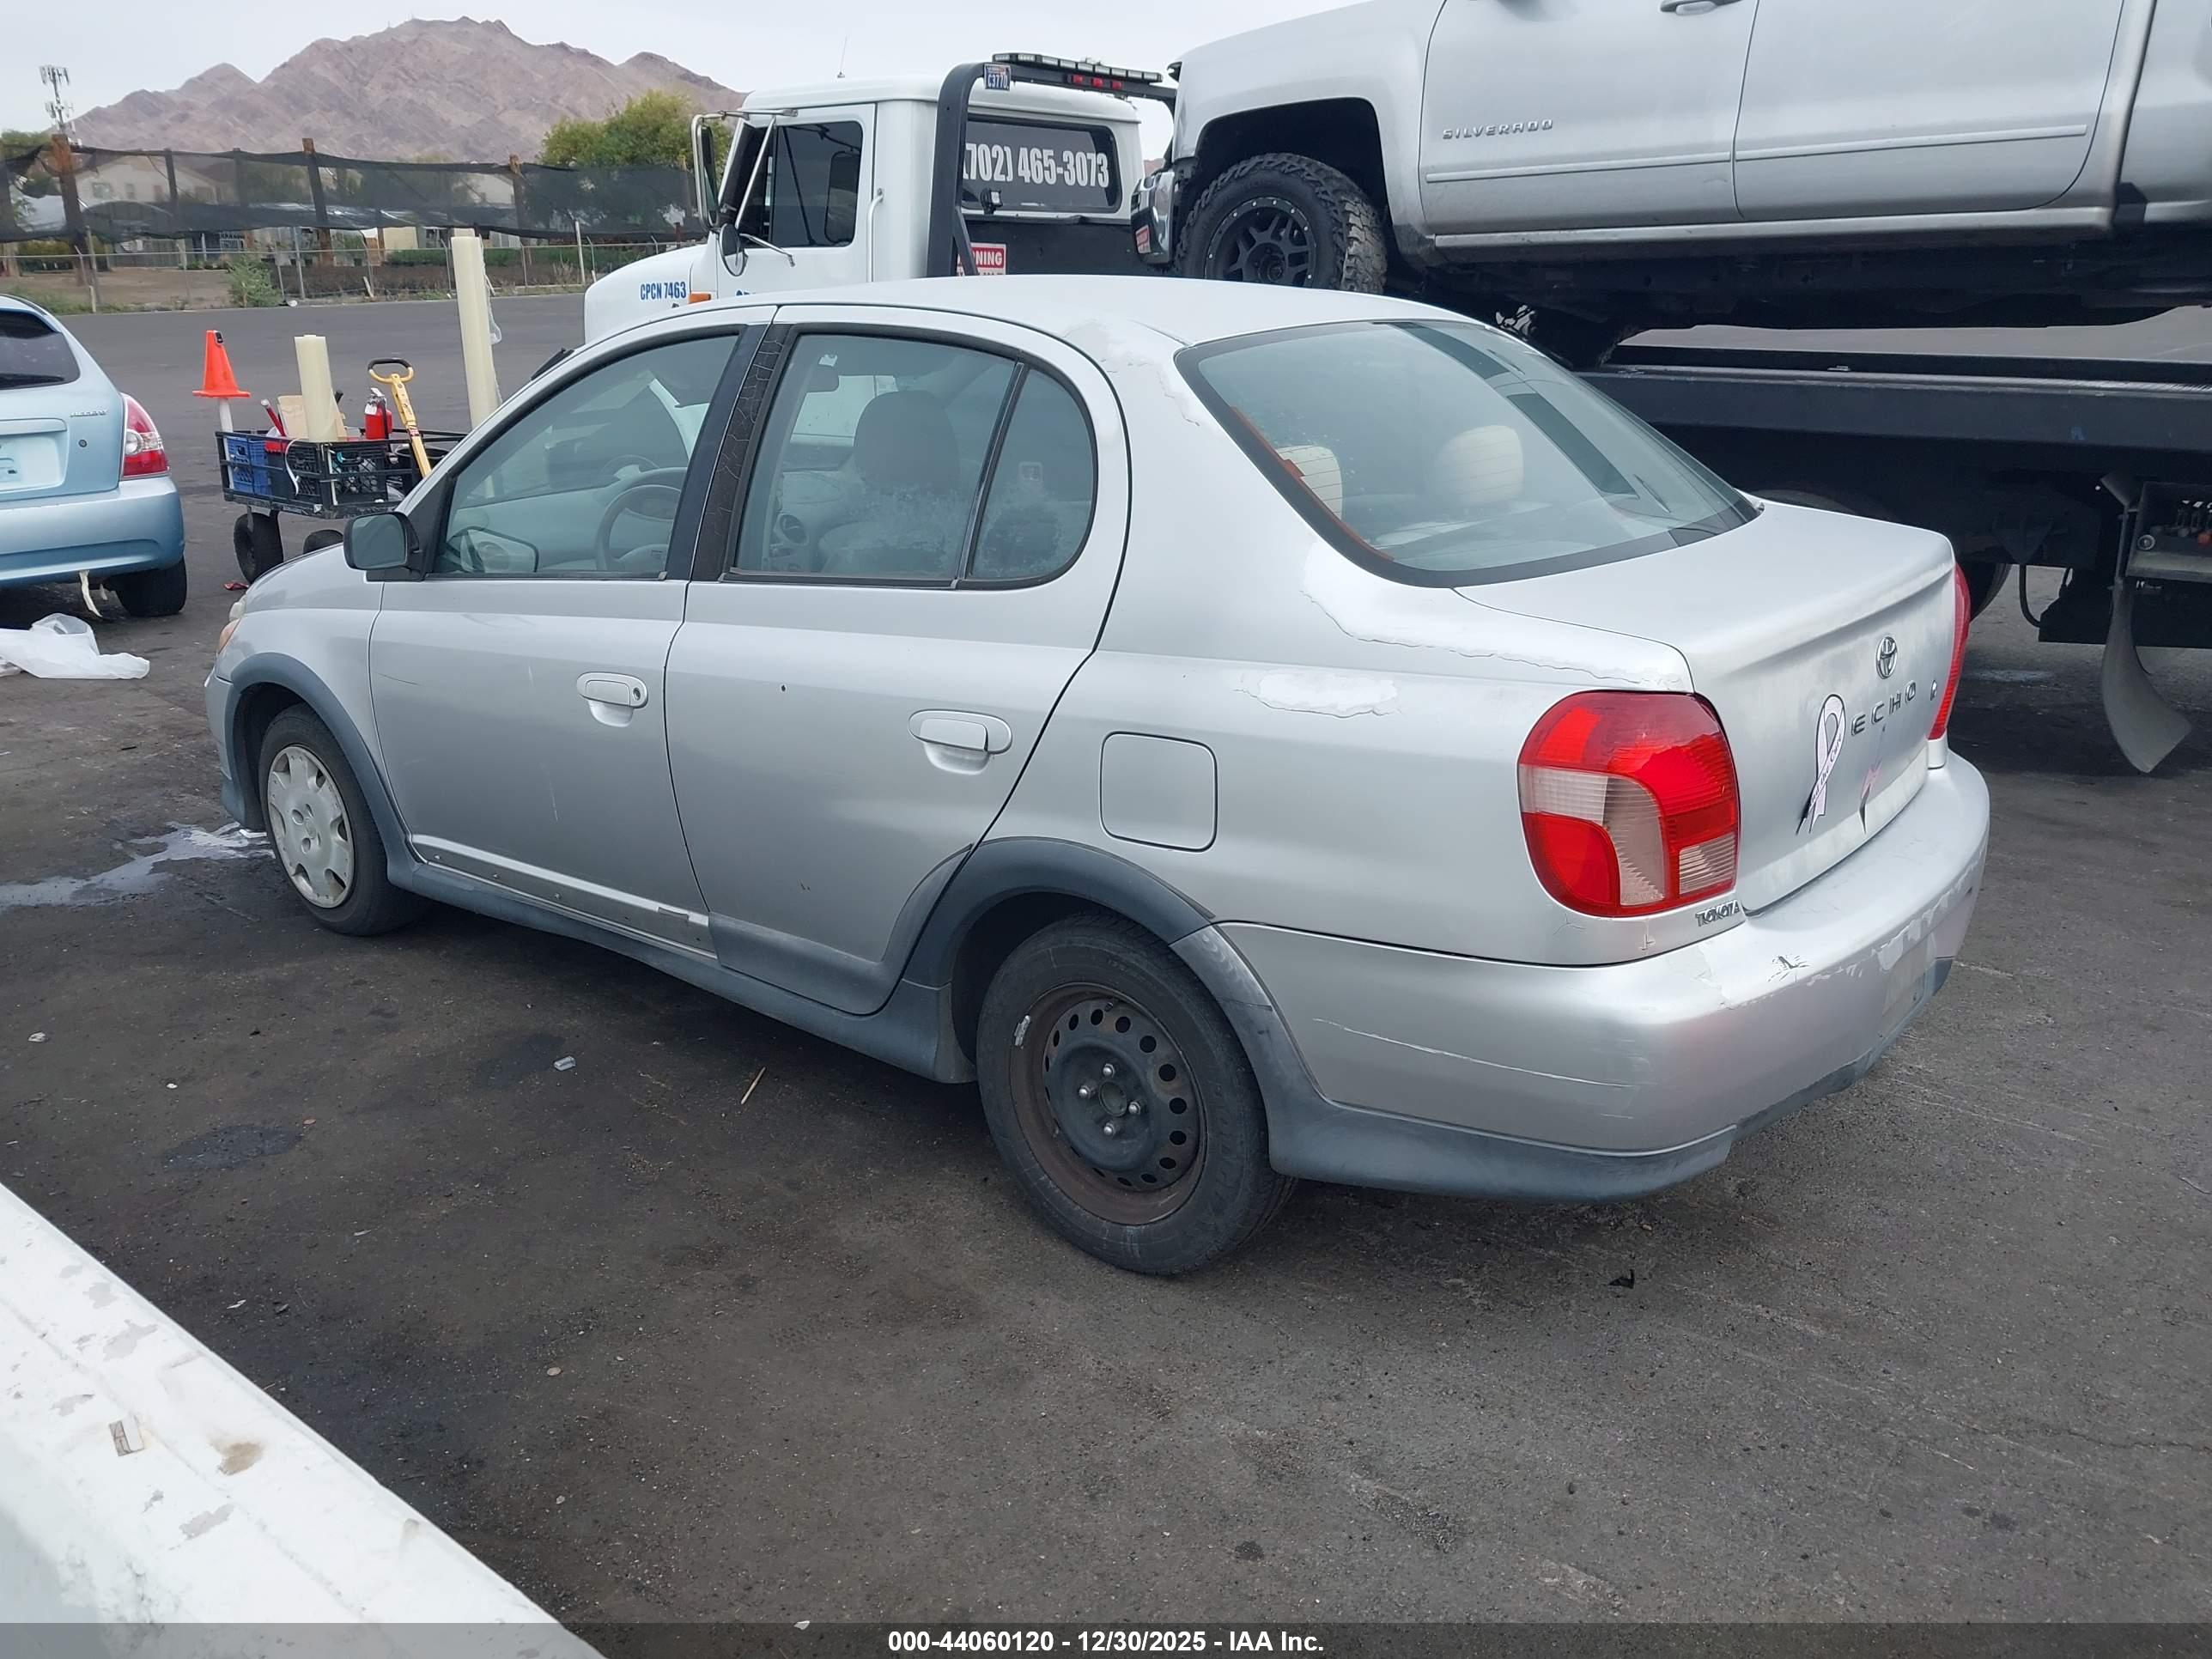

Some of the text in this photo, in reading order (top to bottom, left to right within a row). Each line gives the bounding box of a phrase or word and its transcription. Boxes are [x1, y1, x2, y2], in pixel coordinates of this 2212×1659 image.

[1442, 118, 1554, 140] SILVERADO
[1018, 147, 1109, 188] 465-3073
[973, 251, 1003, 266] NING
[640, 281, 687, 301] CPCN 7463
[1851, 679, 1917, 737] ECHO
[1695, 900, 1741, 927] TOYOTA
